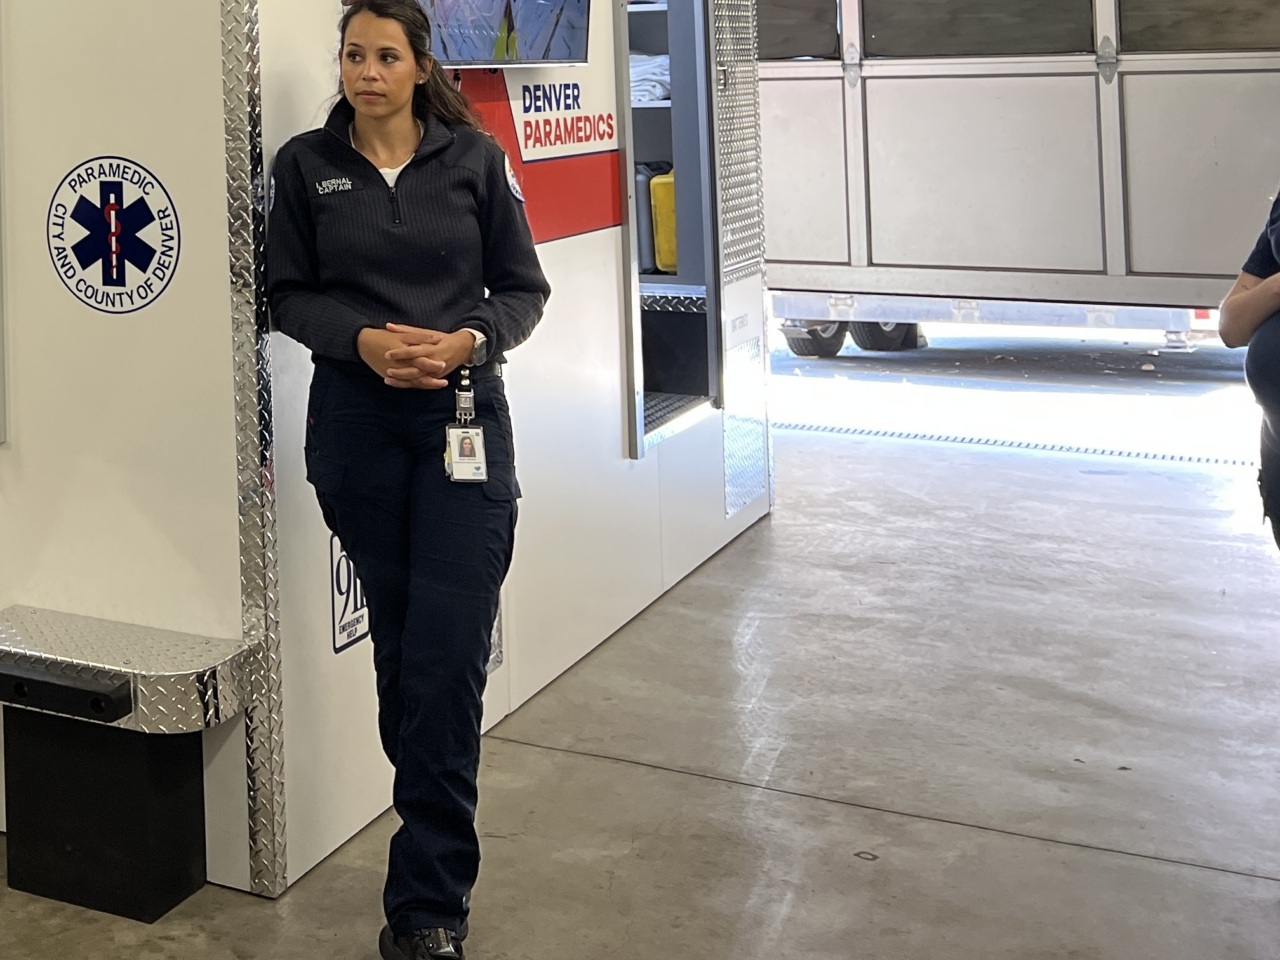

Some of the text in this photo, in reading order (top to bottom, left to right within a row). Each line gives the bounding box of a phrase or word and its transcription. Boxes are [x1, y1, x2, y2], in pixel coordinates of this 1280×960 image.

[522, 83, 581, 113] DENVER
[524, 113, 614, 149] PARAMEDICS
[68, 163, 154, 195] PARAMEDIC
[319, 184, 352, 194] CAPTAIN
[52, 203, 175, 307] CITY AND COUNTY OF DENVER
[339, 613, 364, 634] EMERGENCY
[347, 627, 357, 640] HELP
